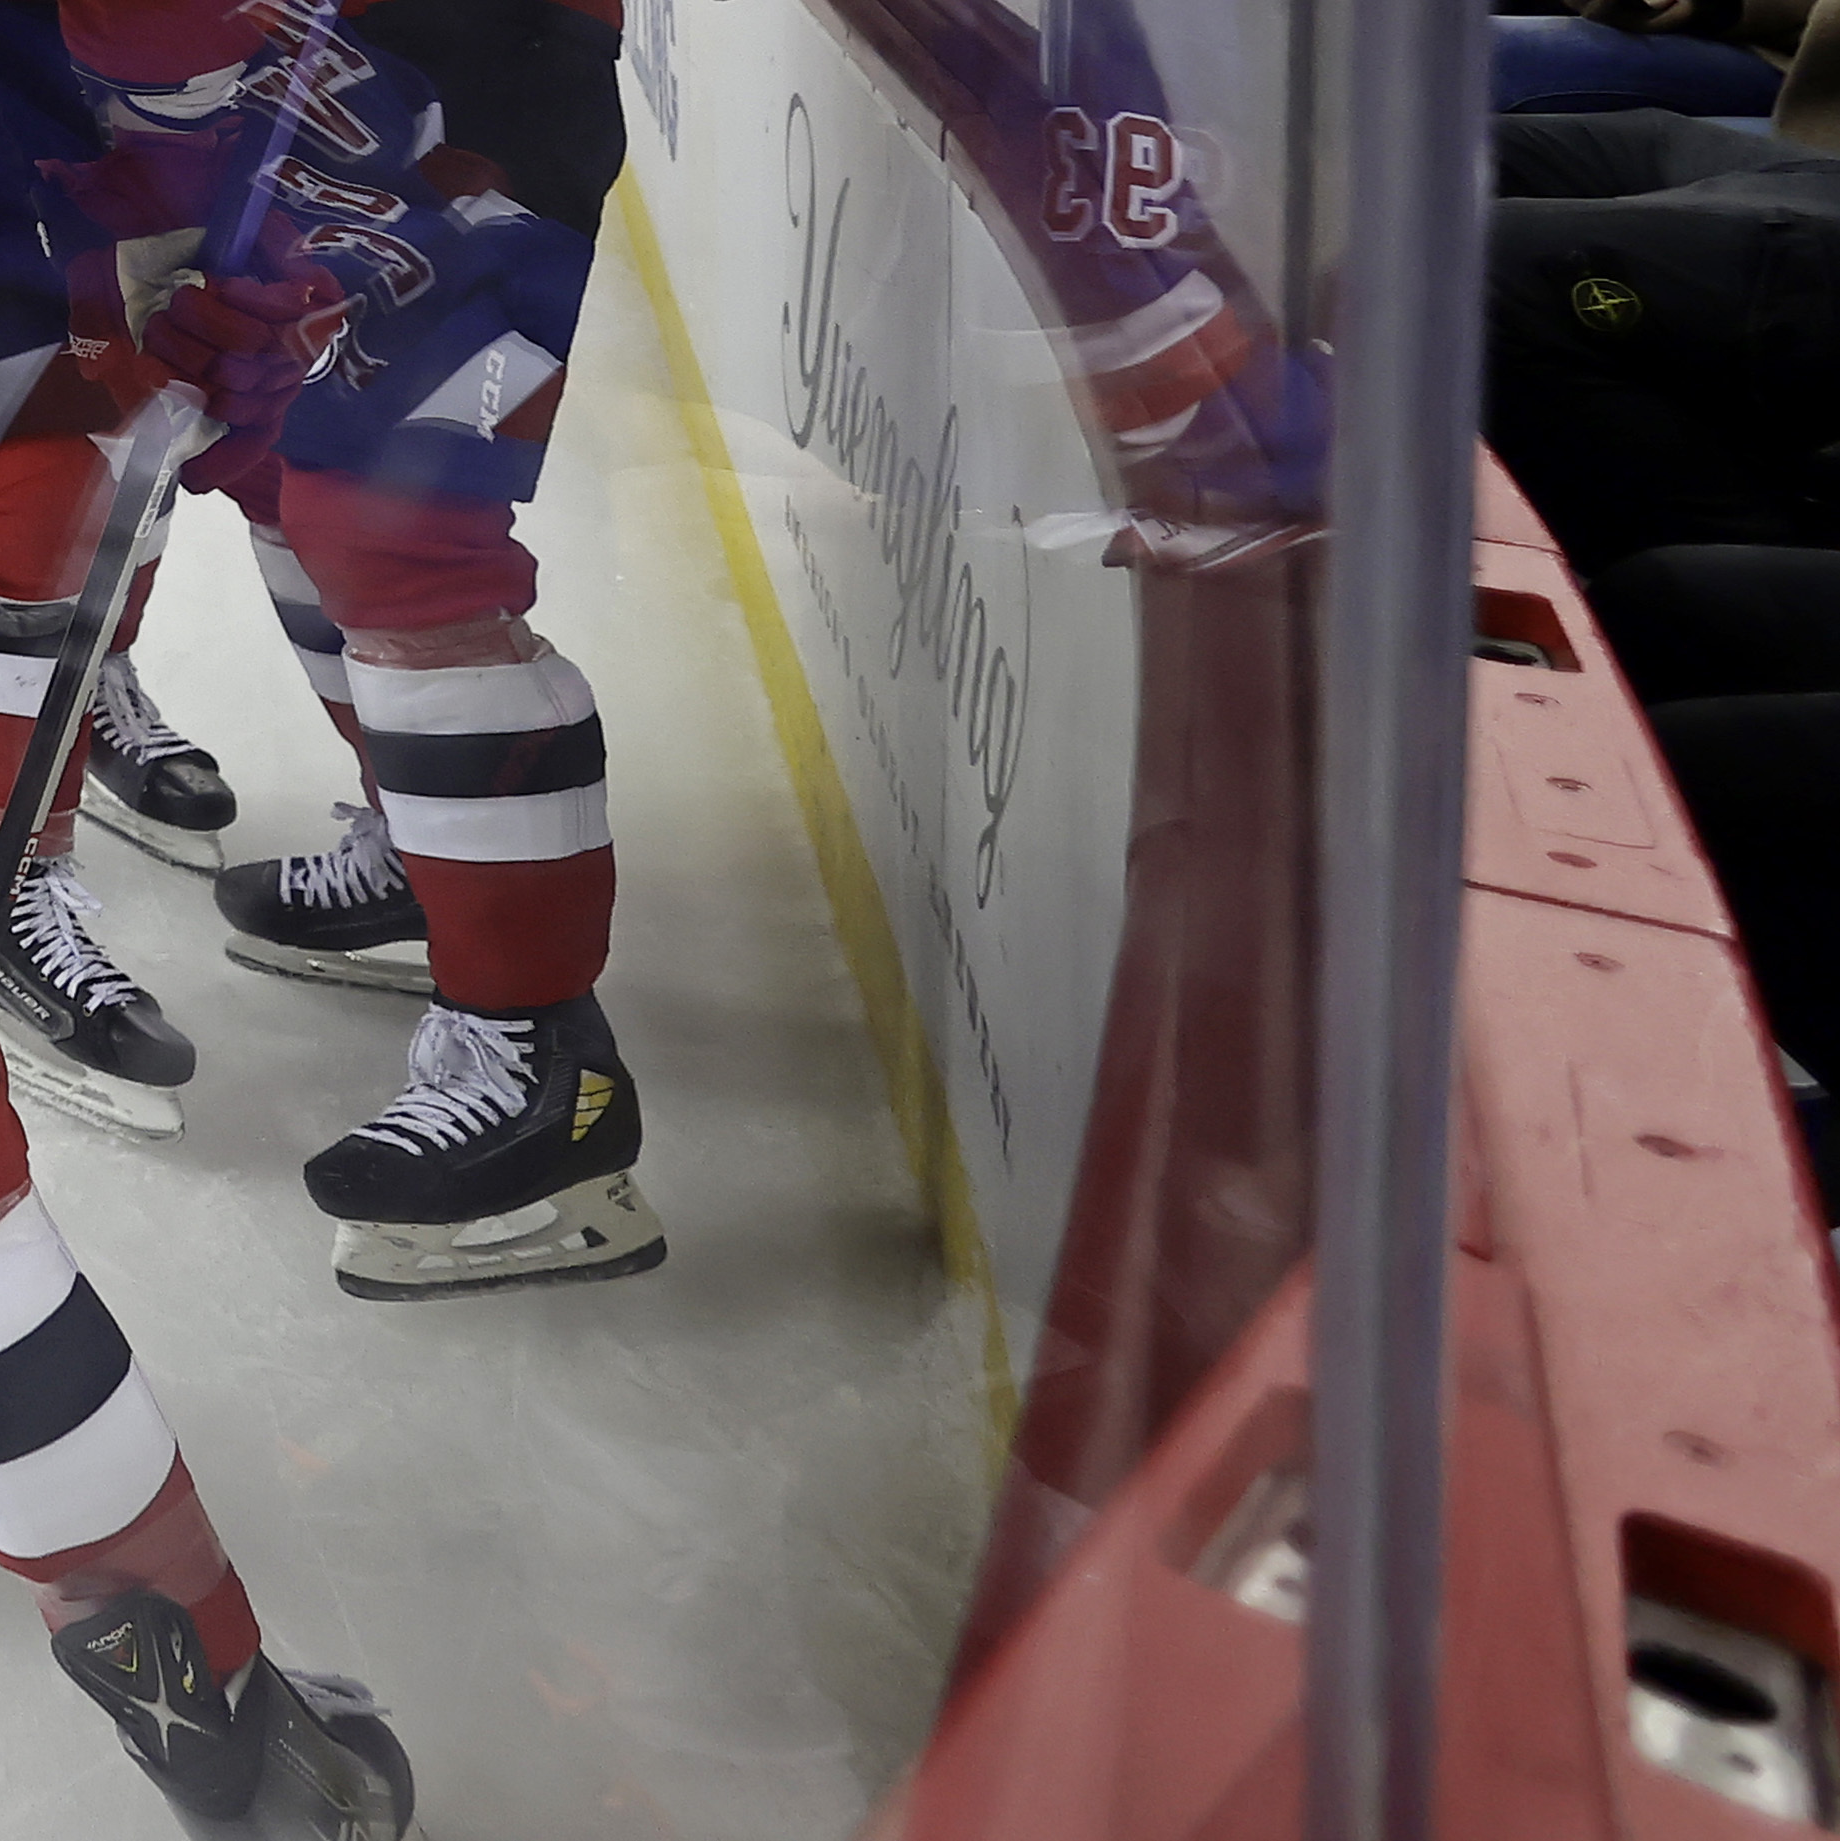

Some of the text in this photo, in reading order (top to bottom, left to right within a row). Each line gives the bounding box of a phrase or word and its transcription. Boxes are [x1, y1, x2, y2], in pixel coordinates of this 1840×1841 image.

[475, 348, 507, 444] CCM
[782, 92, 1031, 910] Yuengling
[10, 834, 41, 903] CCM
